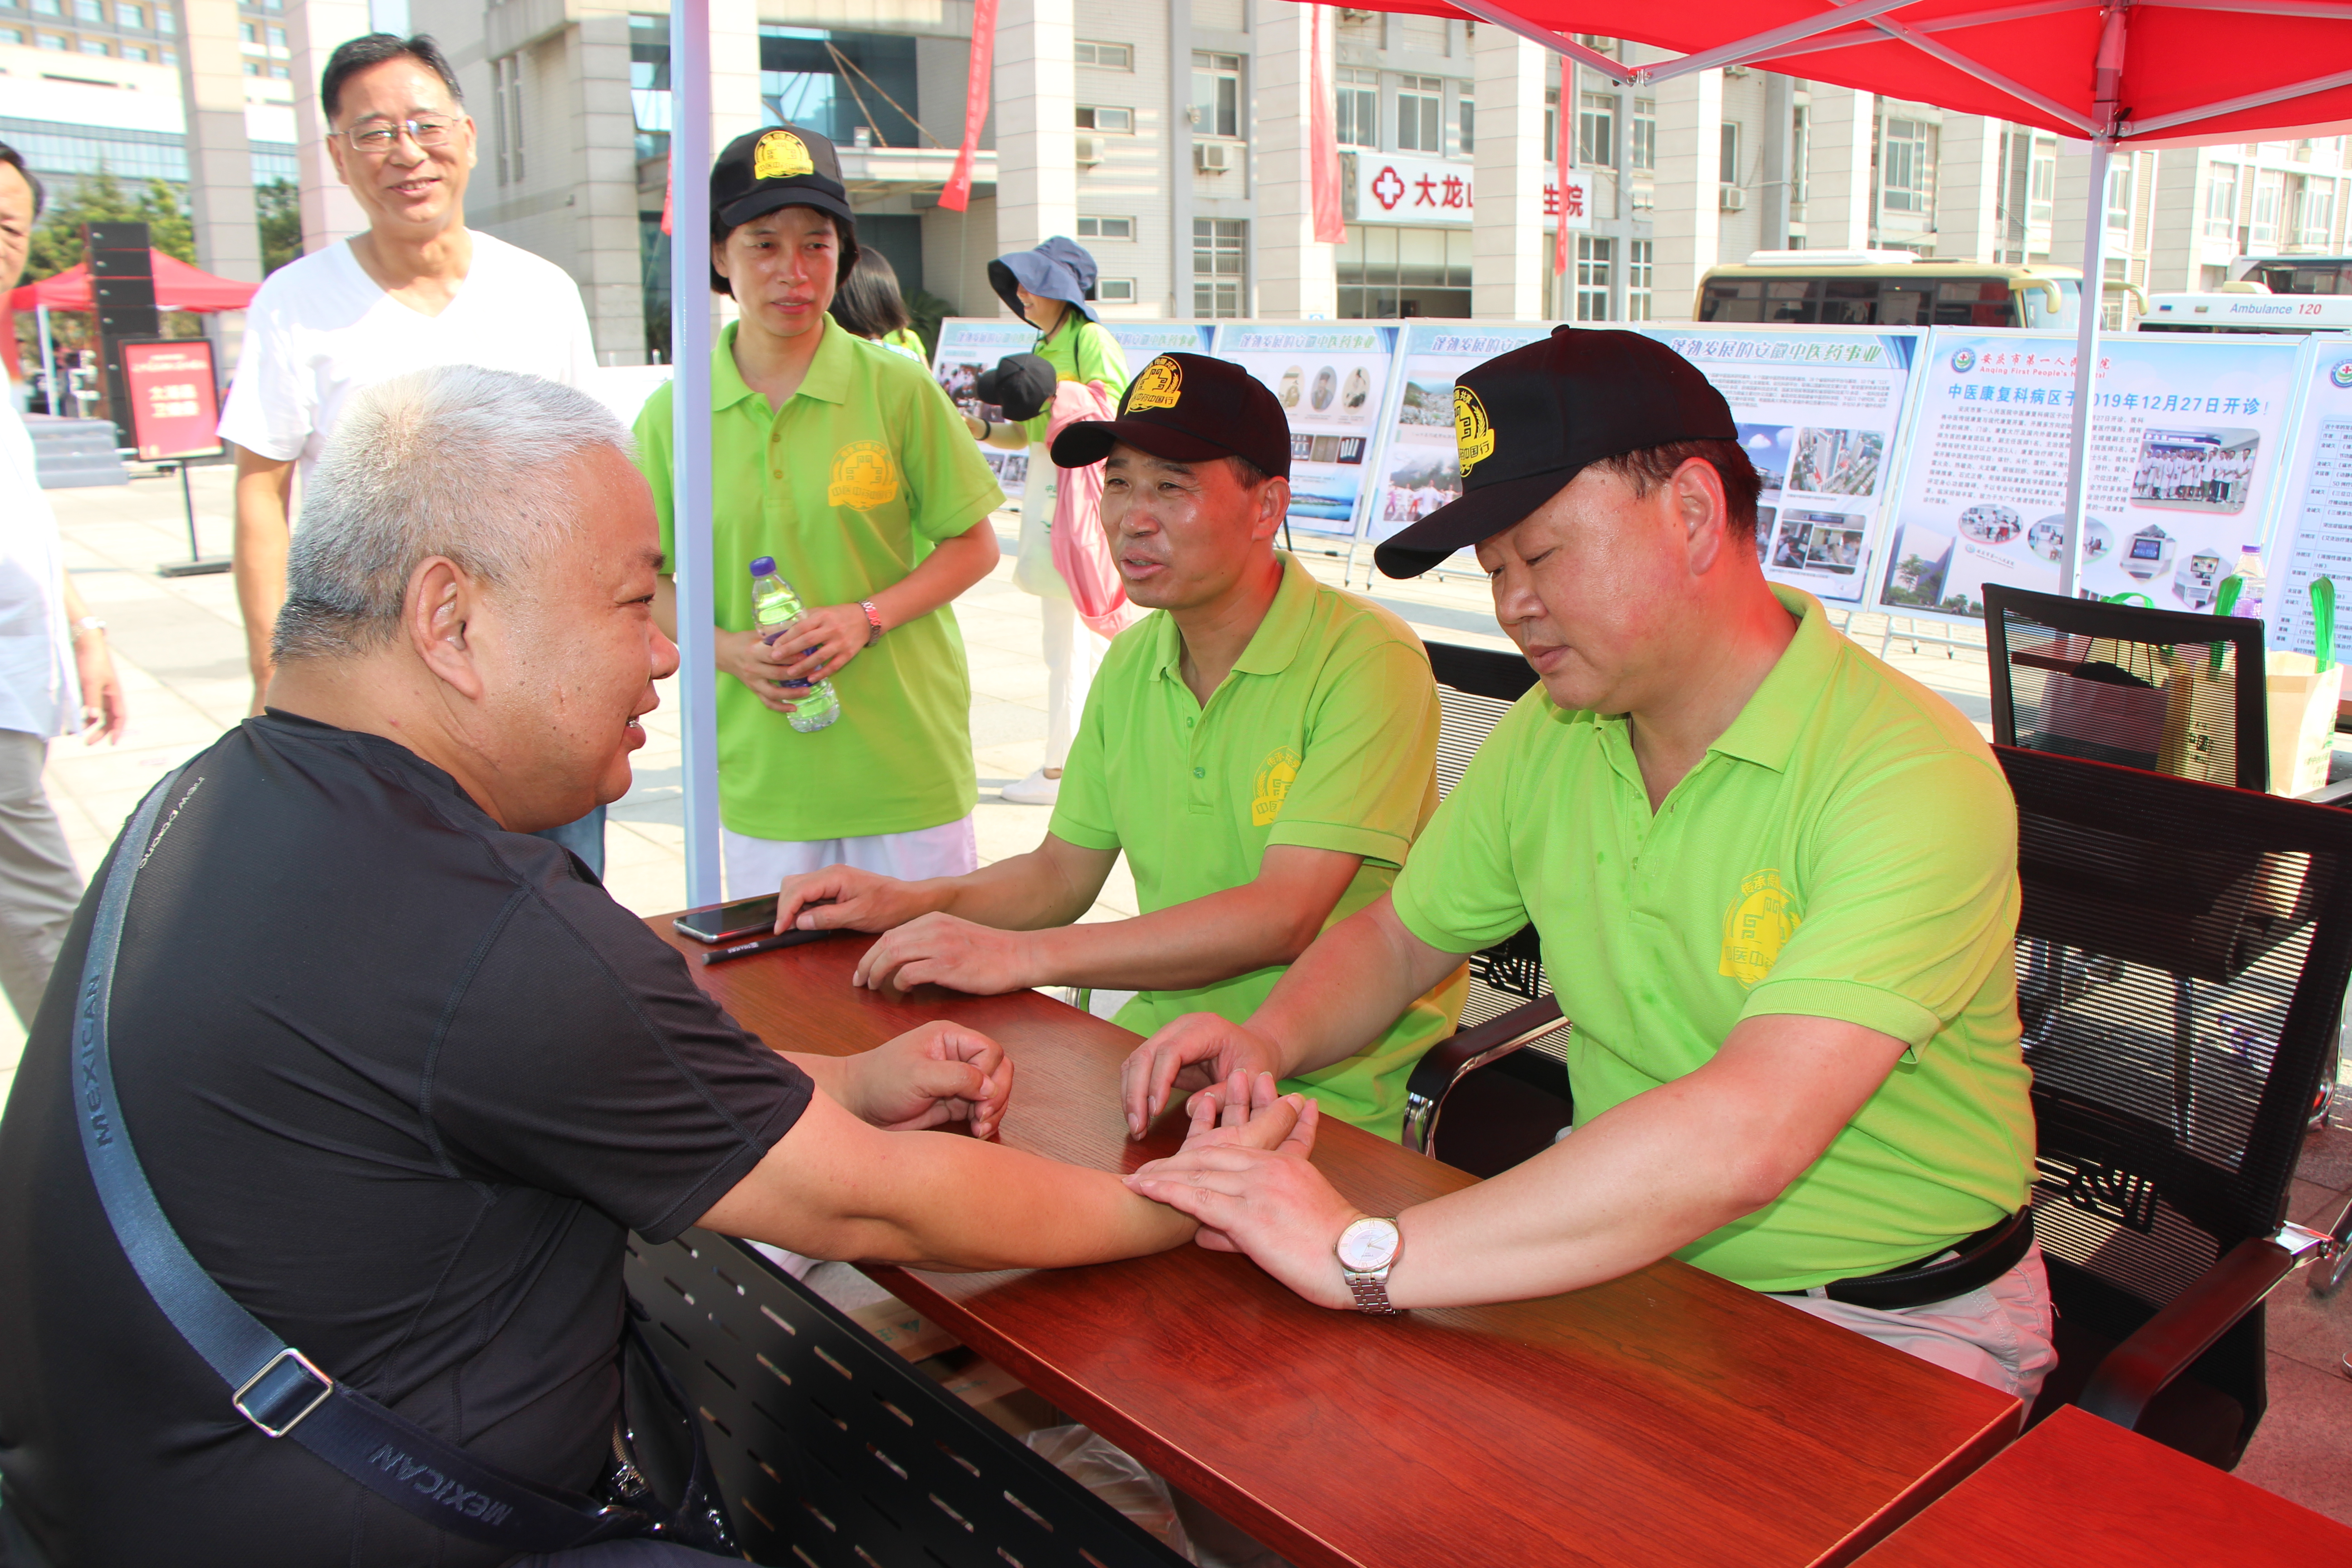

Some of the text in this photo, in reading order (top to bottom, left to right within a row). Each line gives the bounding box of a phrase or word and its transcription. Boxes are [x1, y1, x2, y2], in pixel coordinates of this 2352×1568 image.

[2230, 303, 2322, 314] Ambulance 120
[1980, 353, 2110, 370] 安庆市第一人民院
[1980, 367, 2008, 375] Anqing
[2033, 368, 2067, 377] People's
[139, 809, 180, 869] balanc
[81, 974, 113, 1148] MEXICAN
[368, 1443, 514, 1526] MEXICAN
